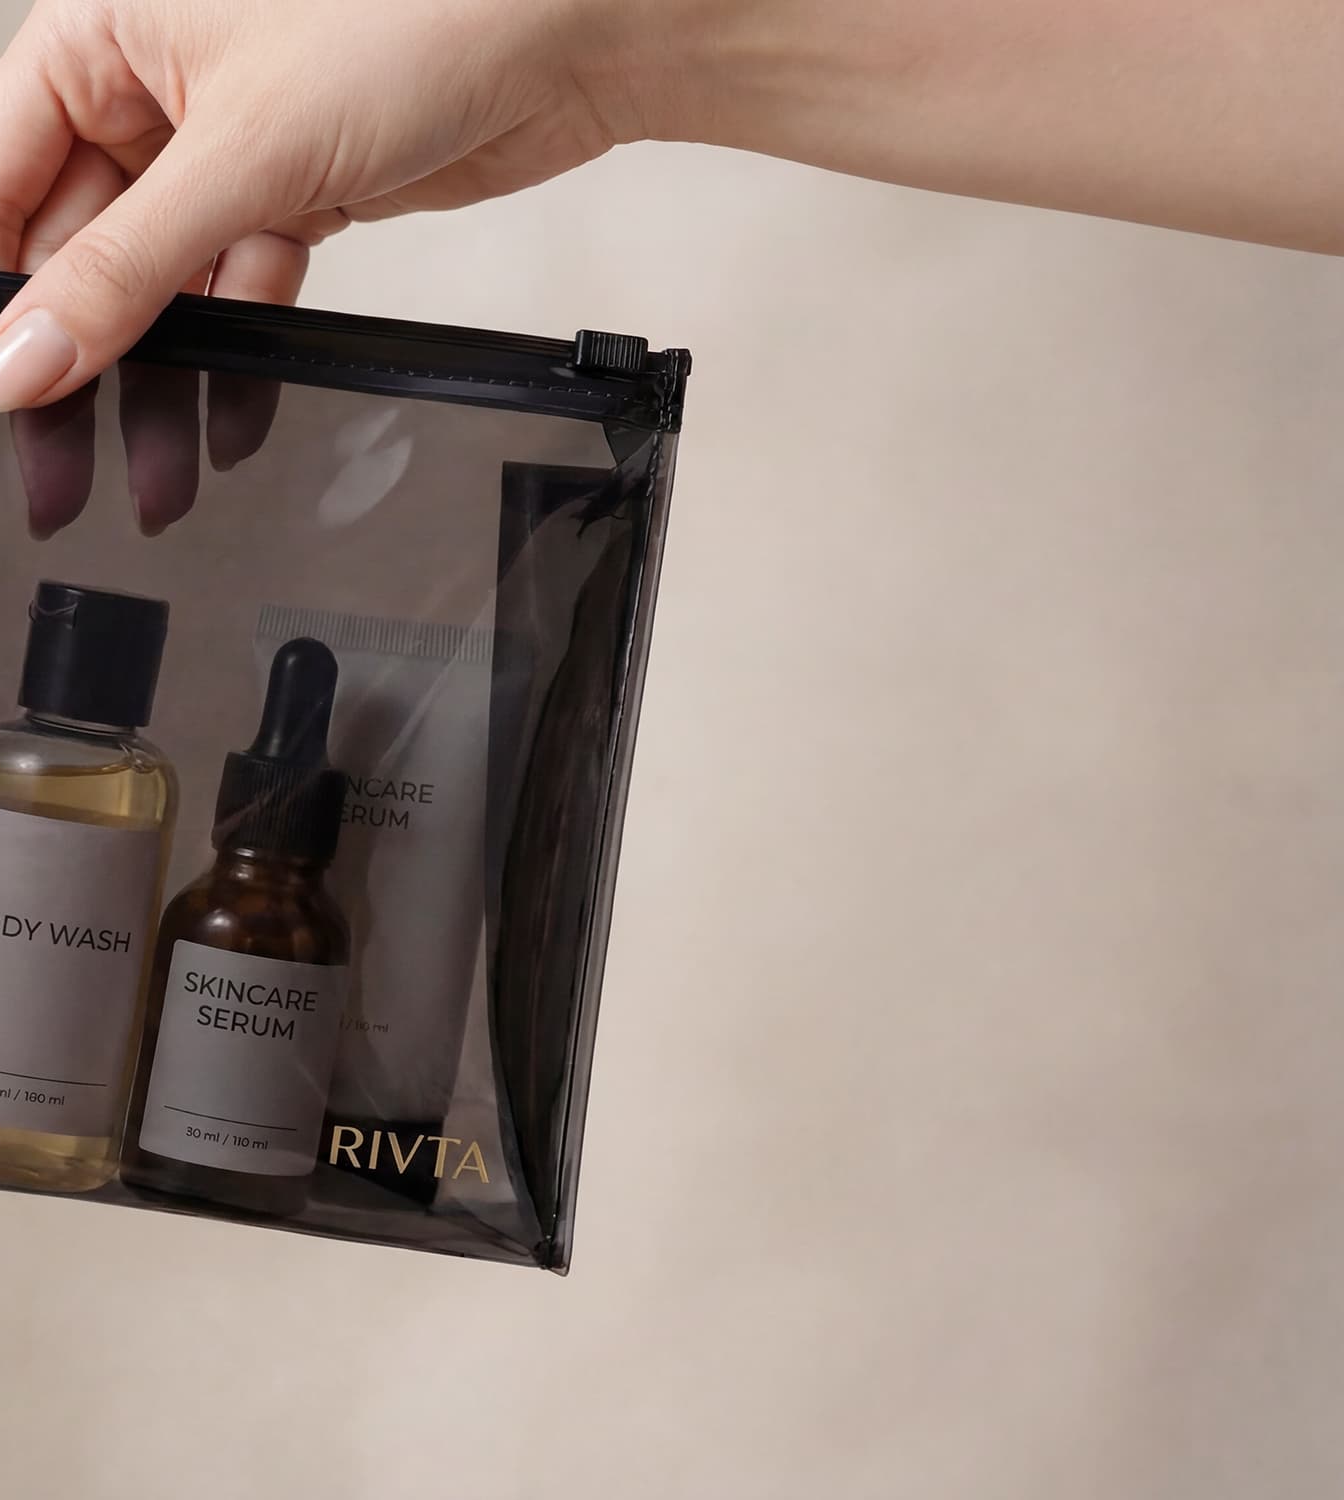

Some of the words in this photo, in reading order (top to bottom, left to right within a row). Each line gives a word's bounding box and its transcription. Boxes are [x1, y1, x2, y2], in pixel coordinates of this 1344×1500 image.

[346, 775, 435, 804] NCARE
[341, 804, 409, 830] ERUM
[49, 922, 132, 953] WASH
[183, 971, 319, 1012] SKINCARE
[196, 1005, 296, 1041] SERUM
[372, 1023, 390, 1033] ml
[13, 1088, 21, 1102] /
[47, 1095, 65, 1106] ml
[185, 1126, 202, 1139] 30
[203, 1131, 220, 1143] ml
[221, 1133, 230, 1146] /
[232, 1135, 250, 1148] 110
[251, 1140, 269, 1151] ml
[328, 1125, 490, 1184] RIVTA
